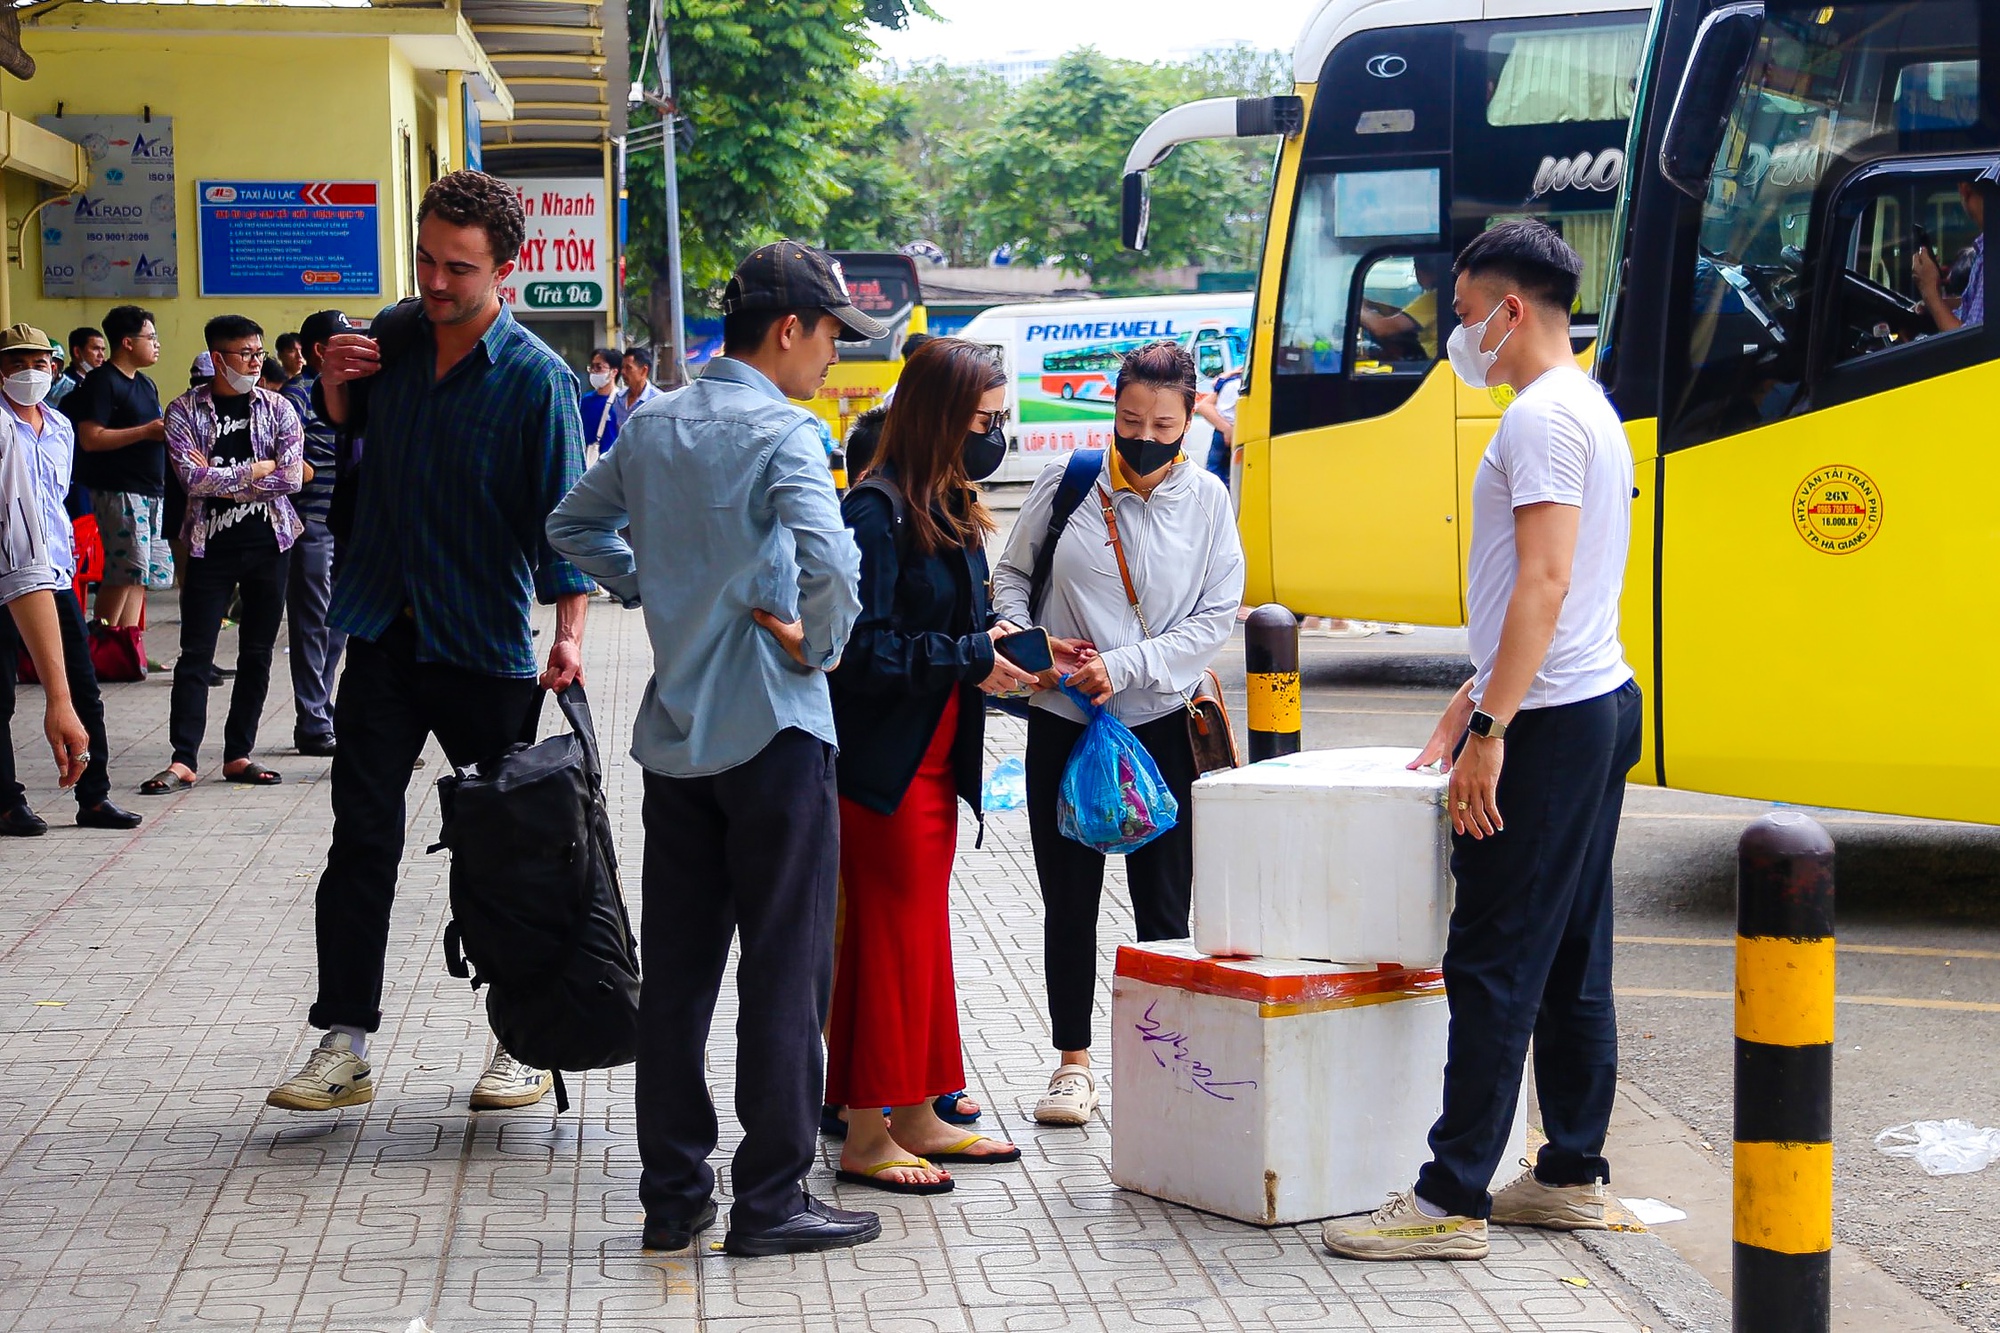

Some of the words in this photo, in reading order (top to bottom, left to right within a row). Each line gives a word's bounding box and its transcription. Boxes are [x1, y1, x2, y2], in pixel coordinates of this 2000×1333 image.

[74, 194, 143, 217] ALRADO
[239, 190, 261, 200] TAXI
[278, 190, 296, 203] LẠC
[541, 192, 595, 216] Nhanh
[86, 232, 103, 241] ISO
[518, 229, 547, 272] MỲ
[552, 228, 595, 272] TÔM
[533, 284, 563, 304] Trà
[566, 284, 593, 304] Đá
[1026, 320, 1179, 342] PRIMEWELL
[1823, 467, 1844, 480] TẢI
[1801, 475, 1822, 496] VẬN
[1797, 498, 1807, 522] HTX
[1868, 498, 1879, 523] PHÚ
[1822, 517, 1858, 527] 16.000.KG
[1806, 530, 1820, 545] TP.
[1820, 540, 1836, 550] HÀ
[1837, 531, 1868, 550] GIANG
